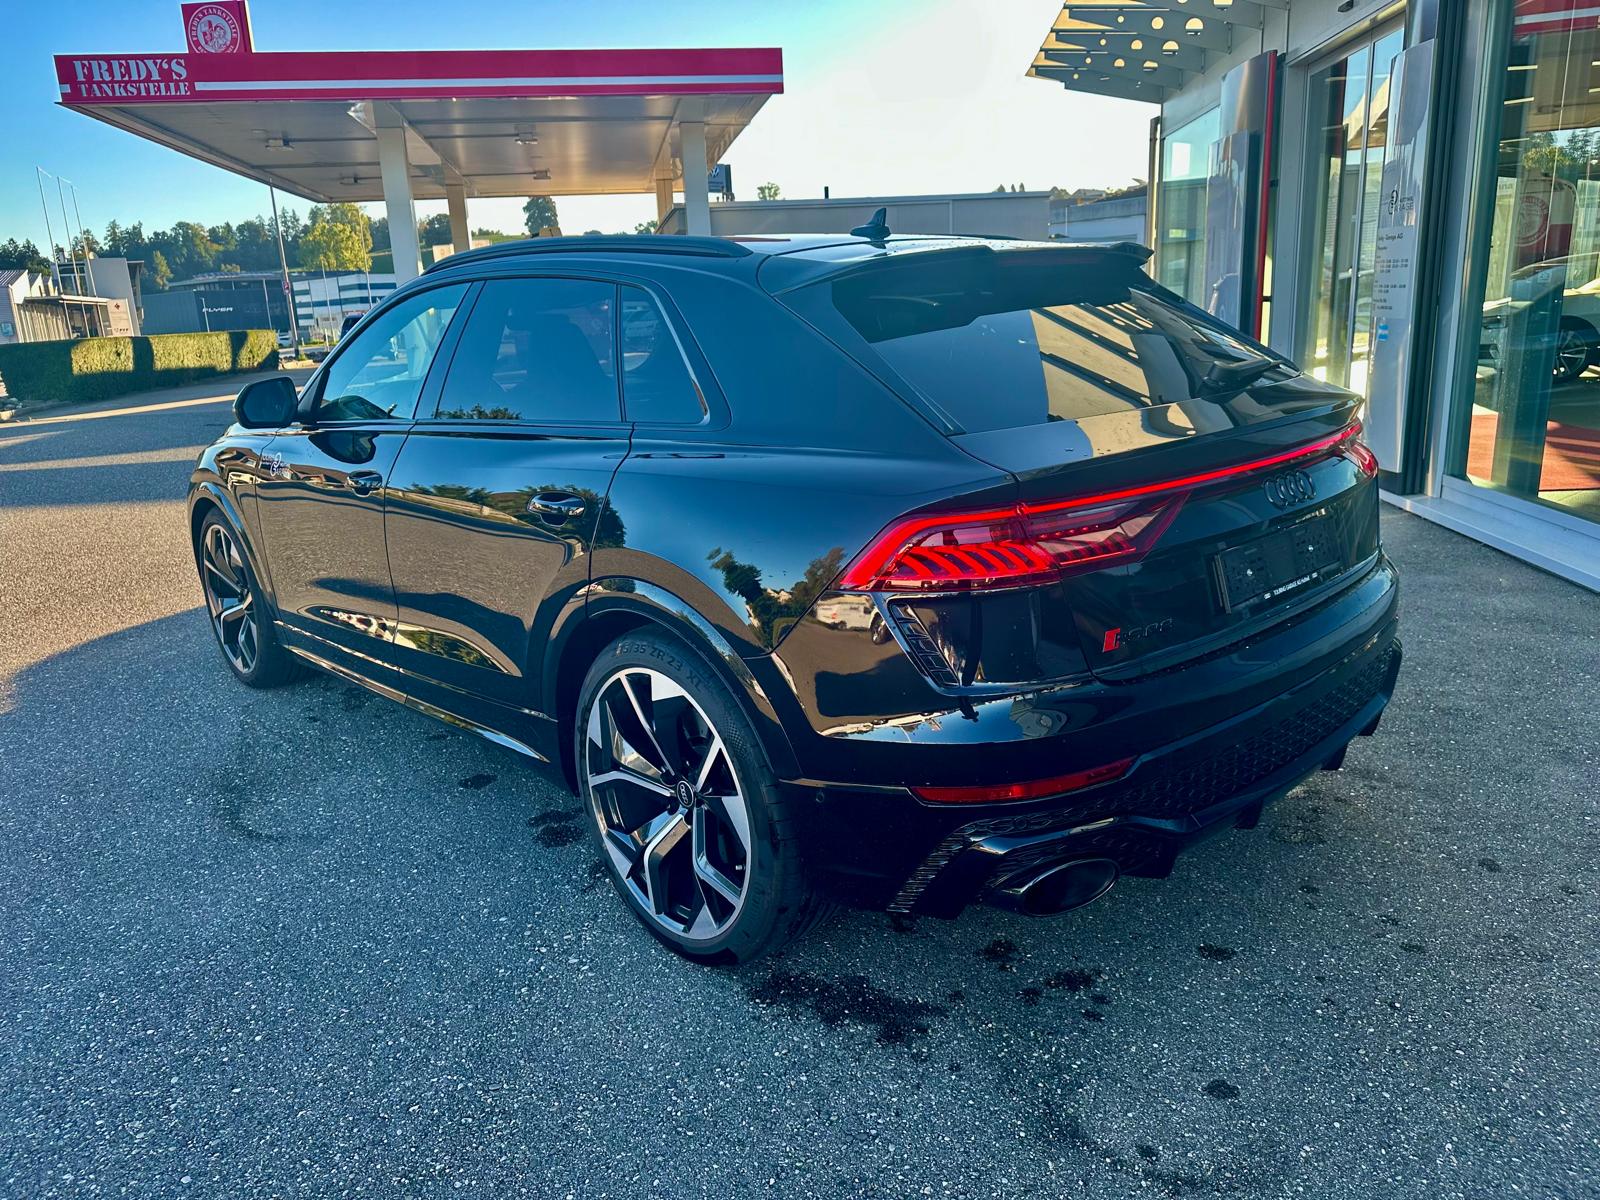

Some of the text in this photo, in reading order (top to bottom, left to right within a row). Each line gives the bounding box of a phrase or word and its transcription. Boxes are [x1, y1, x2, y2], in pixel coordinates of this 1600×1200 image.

[203, 8, 238, 39] TANKSTELLE
[73, 58, 188, 81] FREDY'S
[78, 82, 190, 97] TANKSTELLE
